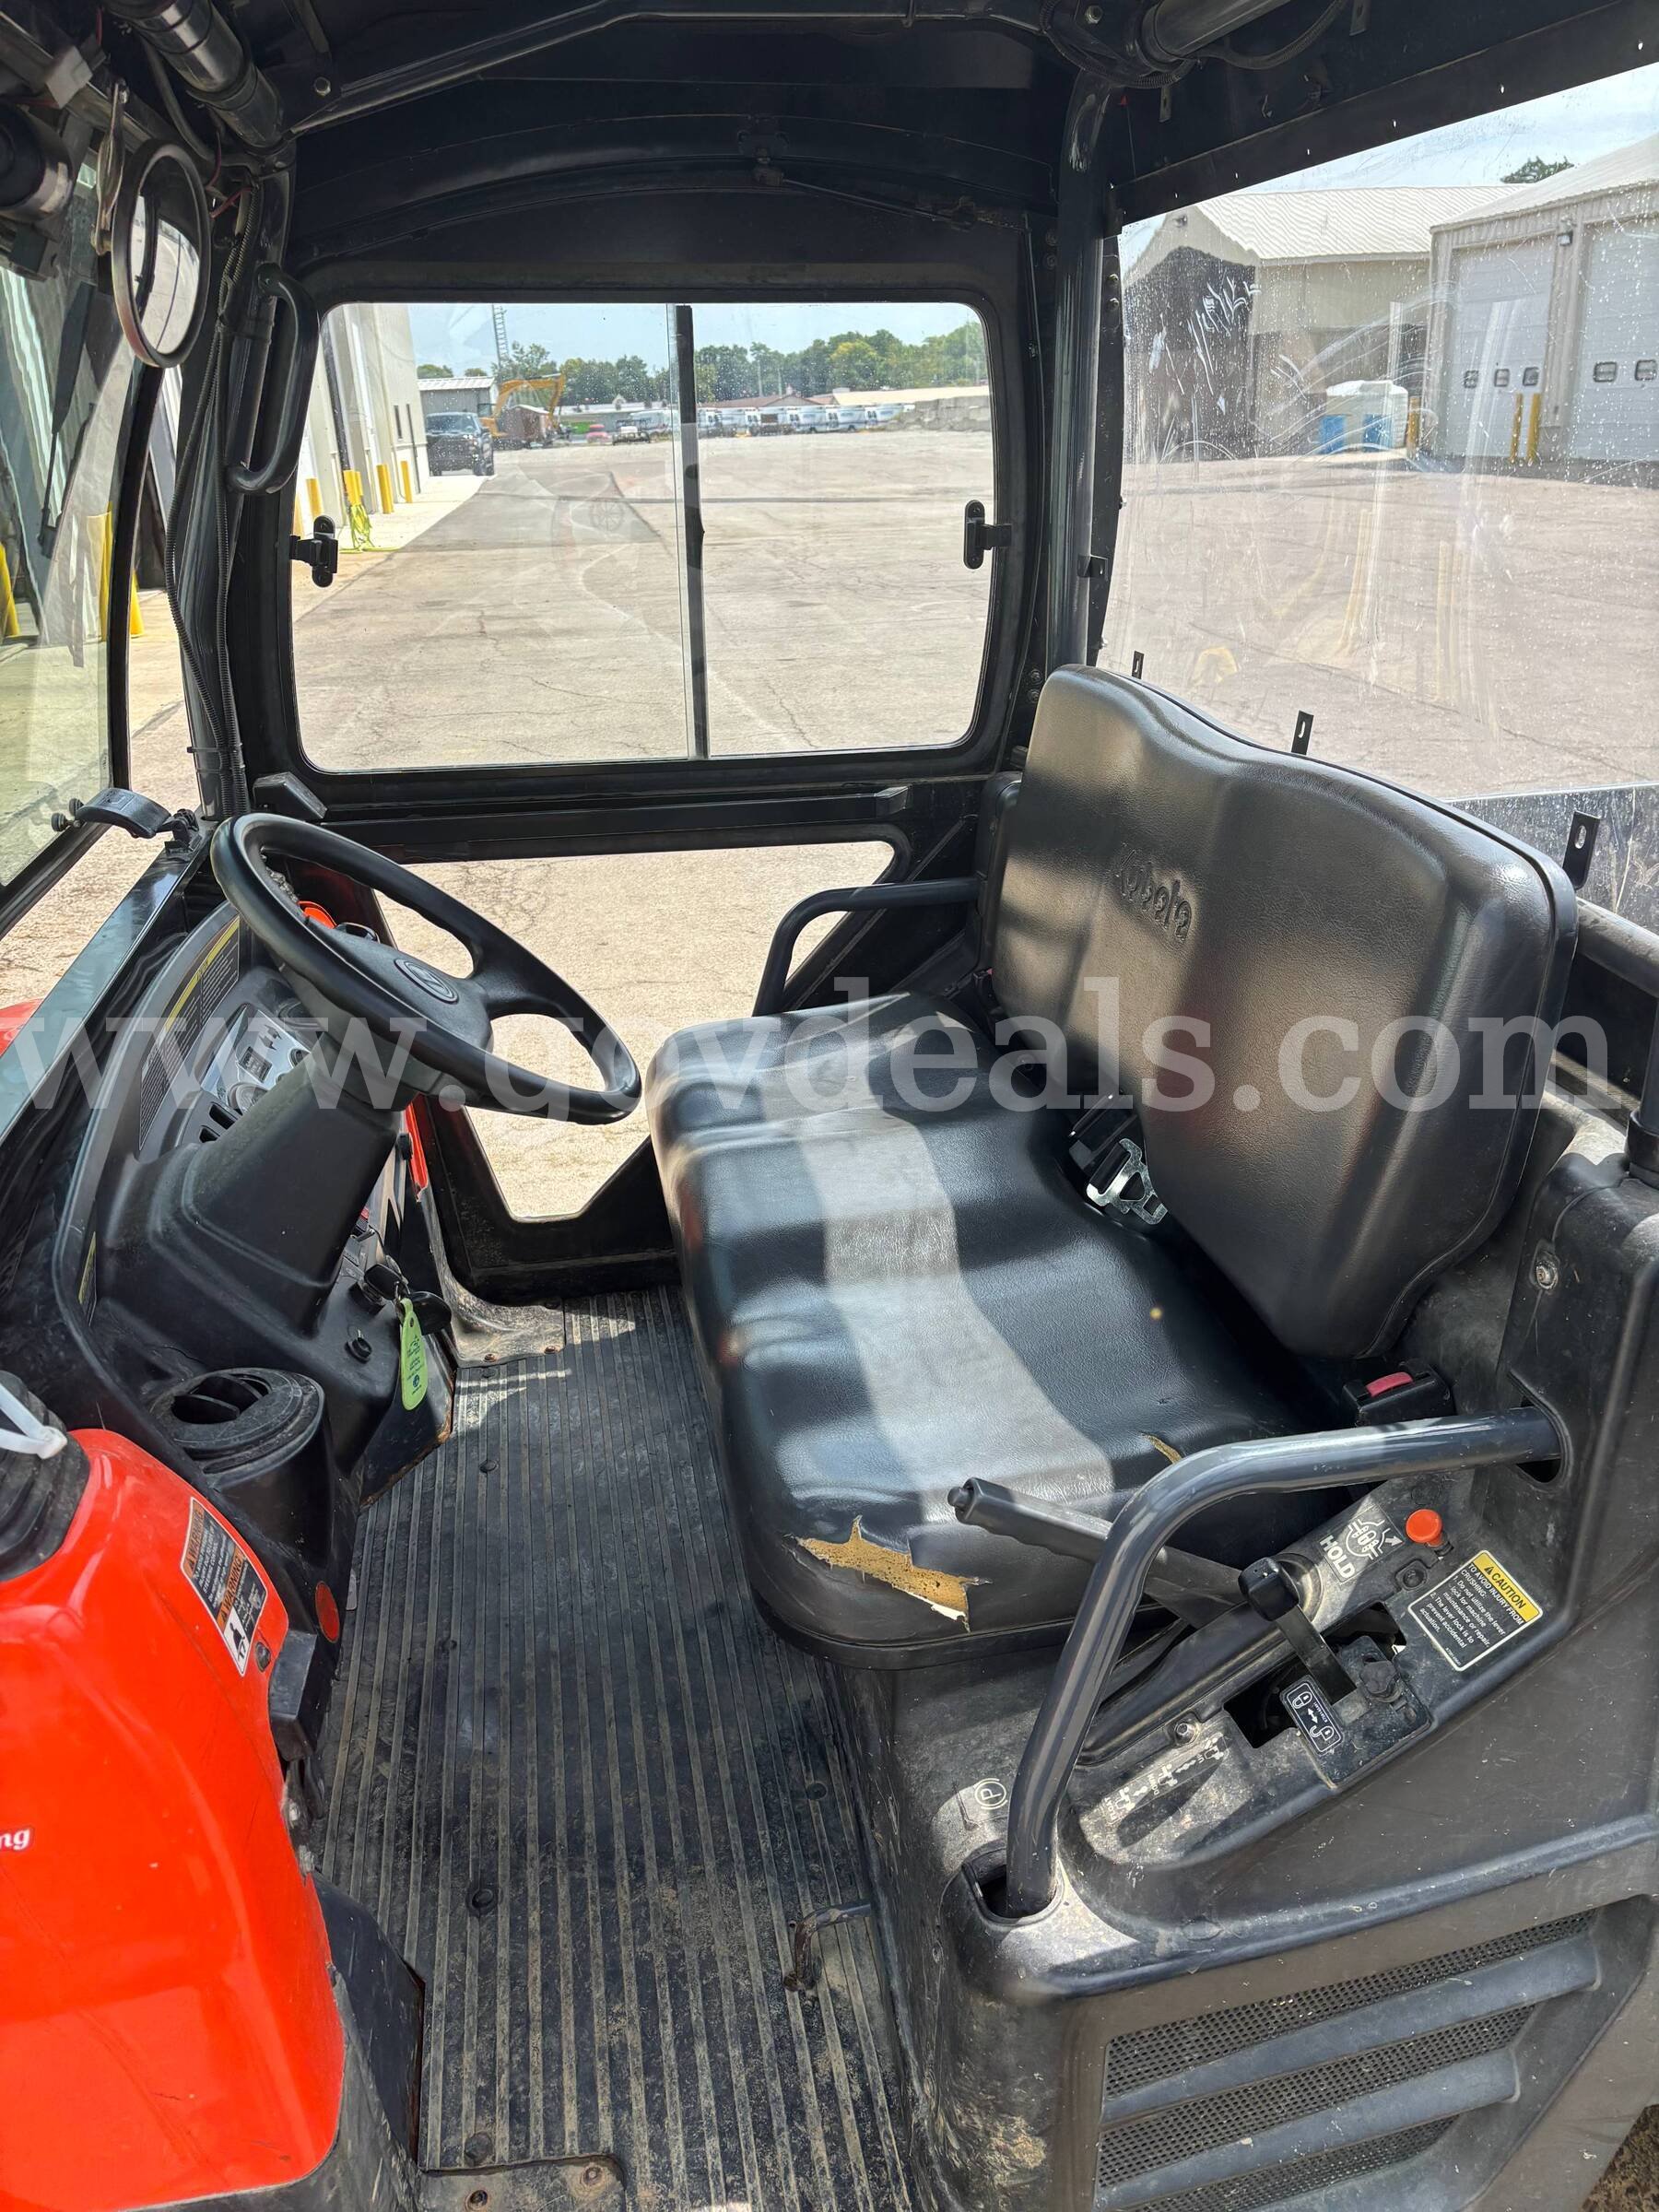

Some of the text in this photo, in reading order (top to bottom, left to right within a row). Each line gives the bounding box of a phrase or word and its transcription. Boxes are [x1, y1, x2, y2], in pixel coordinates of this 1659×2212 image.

[1319, 1535, 1355, 1579] HOLD
[222, 1557, 243, 1609] WARNING
[1460, 1569, 1488, 1599] CRUSHING:
[1467, 1563, 1524, 1625] TO AVOID INJURY FROM
[1491, 1572, 1526, 1609] CAUTION
[1418, 1606, 1441, 1632] actuation.
[1425, 1602, 1445, 1622] prevent
[1441, 1620, 1466, 1648] accidental
[1433, 1596, 1444, 1607] The
[1441, 1606, 1454, 1620] lever
[1452, 1618, 1465, 1631] lock
[1441, 1591, 1471, 1623] maintenance
[1472, 1628, 1491, 1647] repair.
[1449, 1585, 1487, 1627] lock for machine
[1456, 1580, 1465, 1589] Do
[1462, 1587, 1473, 1598] not
[1470, 1595, 1487, 1613] utilize
[1484, 1611, 1494, 1622] the
[1491, 1620, 1505, 1636] lever
[1147, 1773, 1159, 1795] DOWN
[1104, 1796, 1117, 1821] FLOAT
